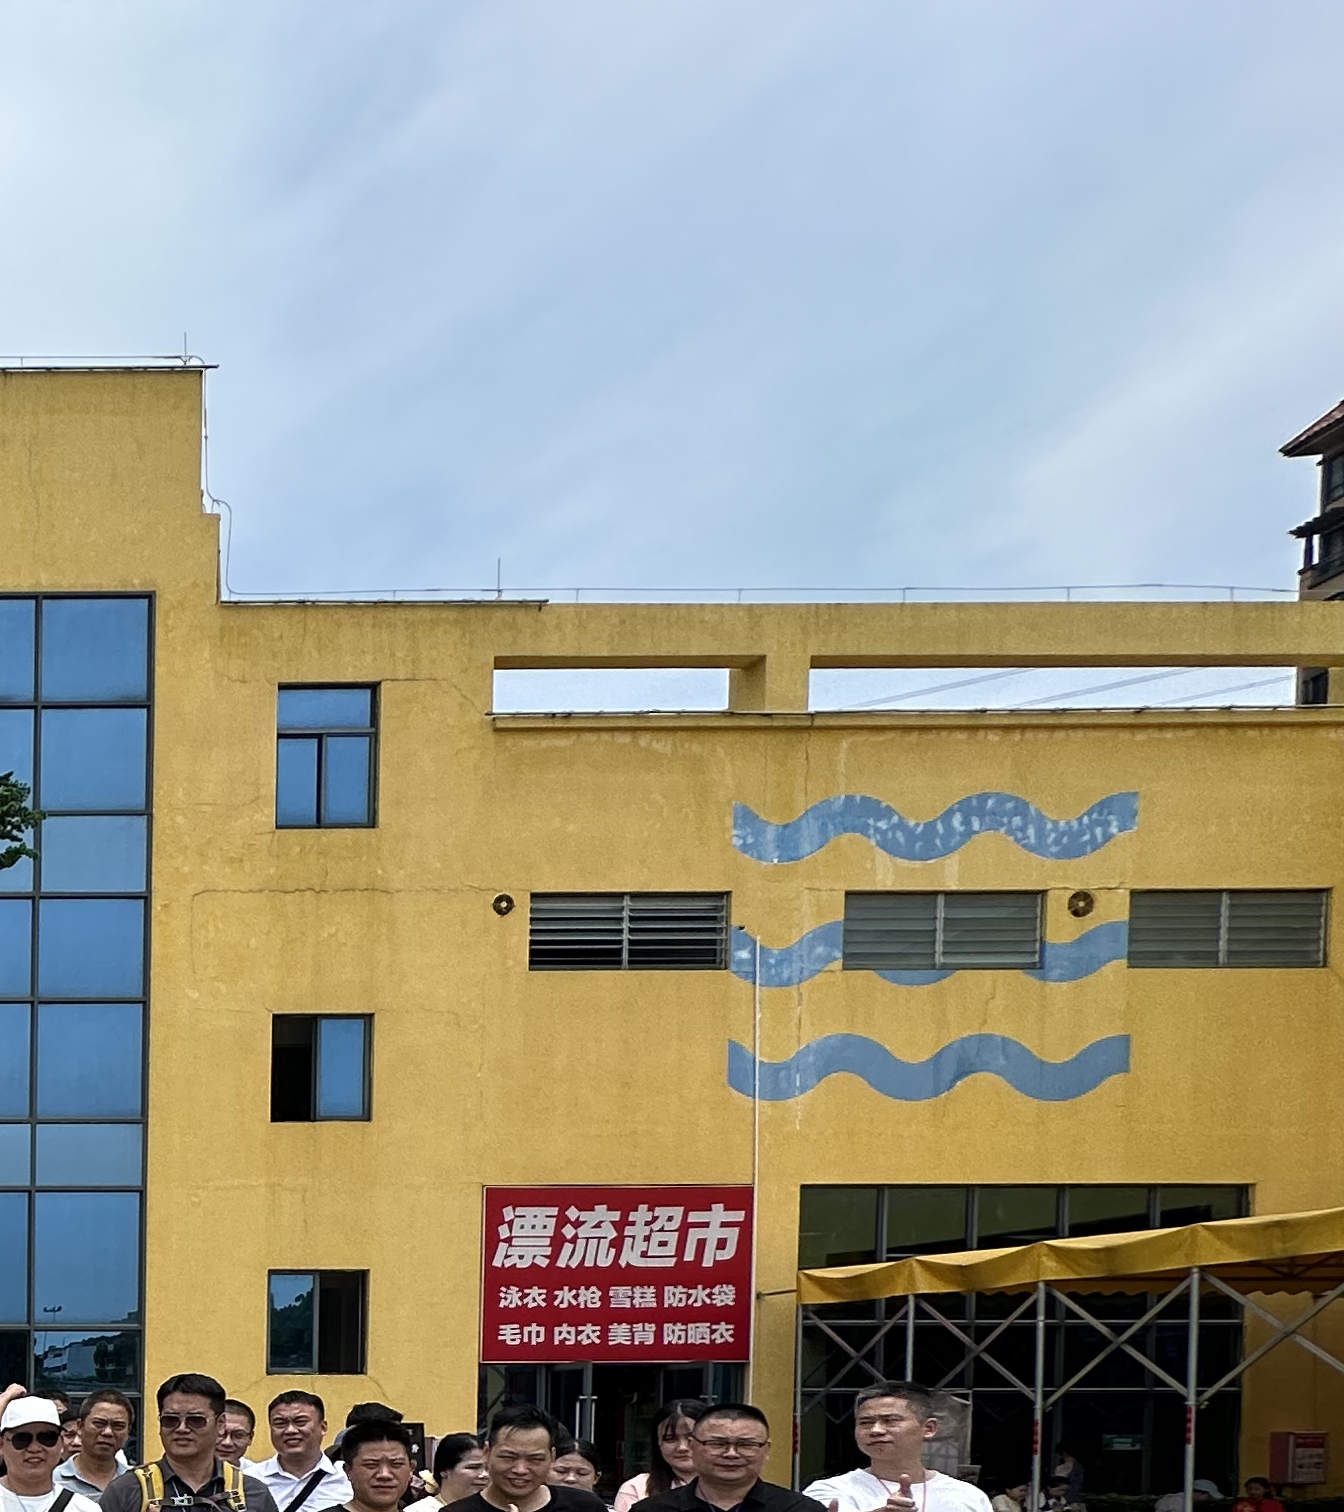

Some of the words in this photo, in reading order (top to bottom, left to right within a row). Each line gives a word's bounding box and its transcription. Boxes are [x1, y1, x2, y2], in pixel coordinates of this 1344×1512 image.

[491, 1203, 745, 1268] 漂流超市
[498, 1285, 547, 1308] 泳衣
[553, 1285, 602, 1308] 水枪
[608, 1285, 657, 1308] 雪糕
[663, 1285, 736, 1308] 防水袋
[498, 1323, 546, 1346] 毛巾
[553, 1323, 602, 1346] 内衣
[608, 1323, 656, 1346] 美背
[663, 1323, 735, 1346] 防晒衣
